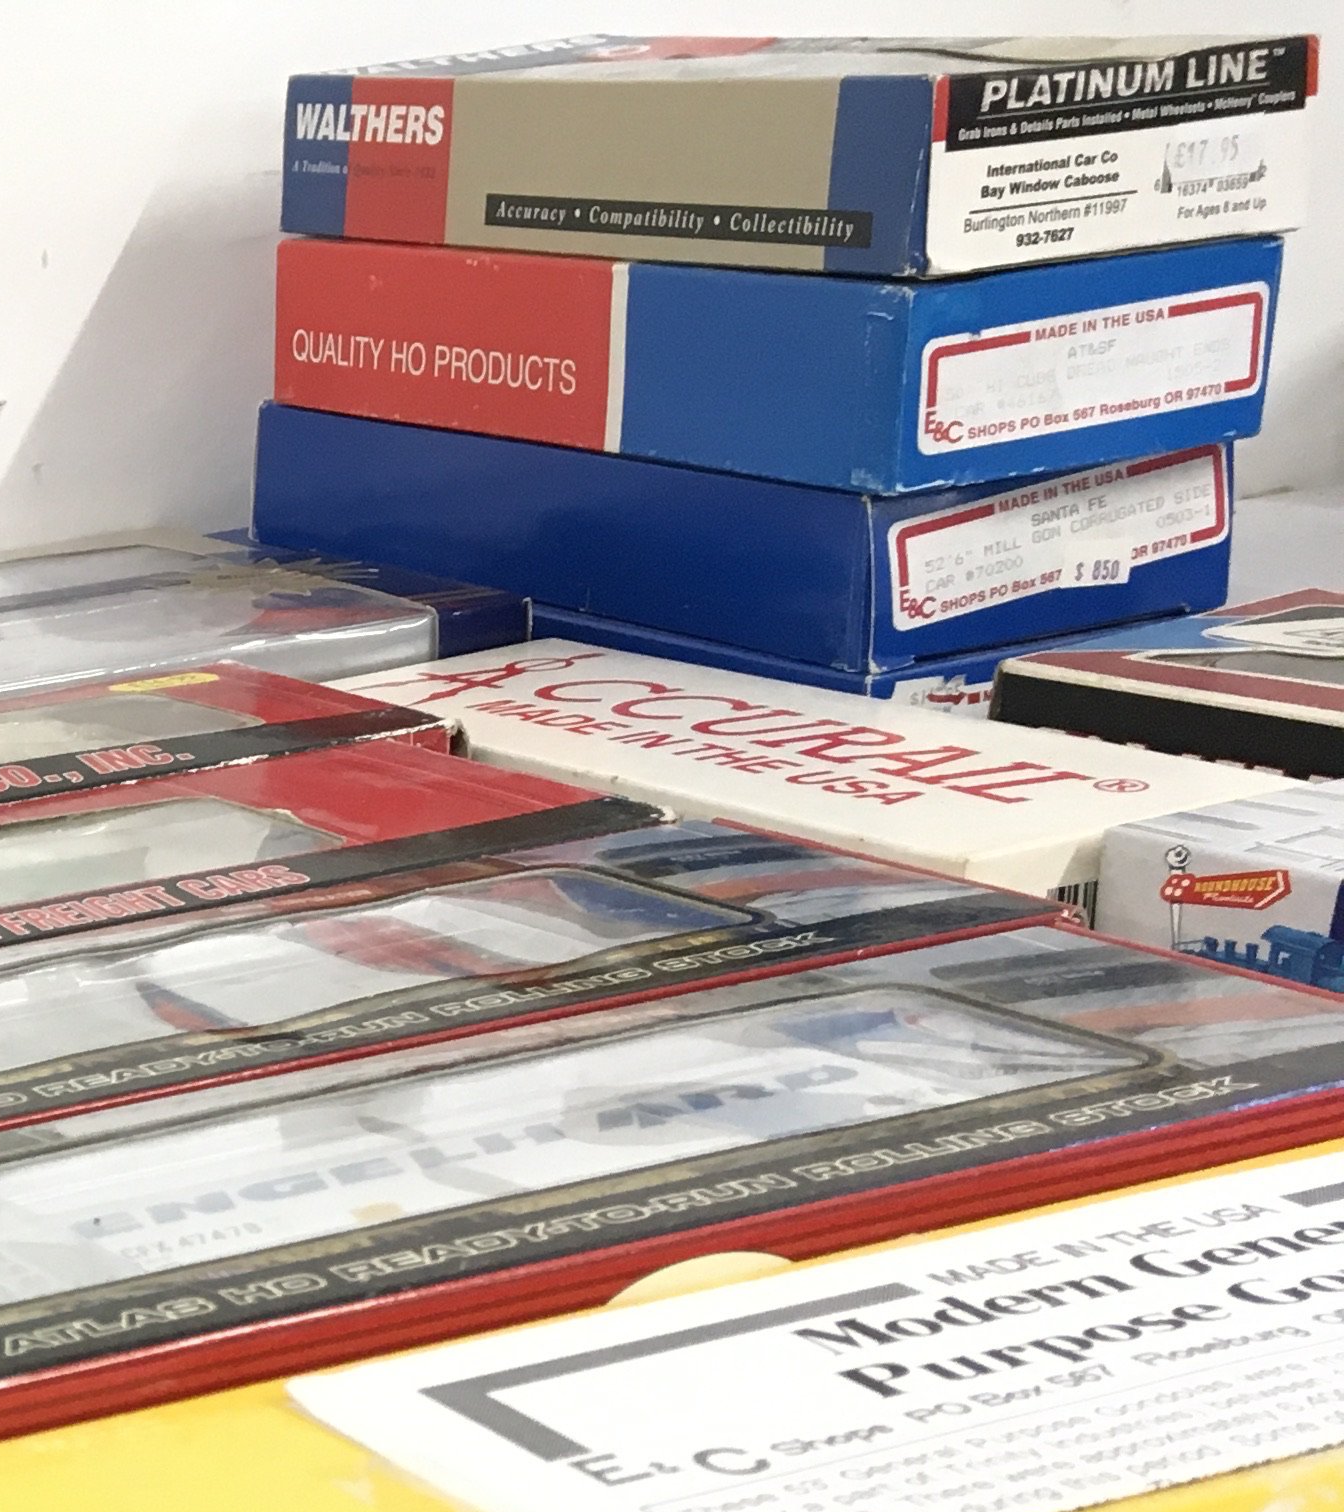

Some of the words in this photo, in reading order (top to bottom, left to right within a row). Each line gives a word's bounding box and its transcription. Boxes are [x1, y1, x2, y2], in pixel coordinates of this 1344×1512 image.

[980, 60, 1175, 112] PLATINUM
[1186, 49, 1269, 88] LINE
[296, 102, 445, 145] WALTHERS
[958, 127, 981, 141] Grab
[983, 125, 1007, 138] Irons
[1010, 123, 1017, 135] &
[1020, 119, 1053, 133] Details
[1055, 117, 1080, 129] Parts
[1082, 110, 1122, 126] Installed
[986, 156, 1071, 178] International
[1074, 153, 1098, 167] Car
[1100, 150, 1119, 164] Co
[980, 185, 1005, 199] Bay
[1009, 178, 1060, 195] Window
[1064, 172, 1120, 188] Caboose
[495, 201, 567, 225] Accuracy
[588, 205, 705, 234] Compatibility
[729, 212, 855, 243] Collectibility
[963, 212, 1025, 233] Burlington
[1028, 206, 1081, 225] Northern
[1083, 198, 1128, 217] #11997
[1177, 206, 1195, 219] For
[1232, 199, 1250, 212] and
[1253, 197, 1267, 211] Up
[1034, 324, 1078, 342] MADE
[1082, 319, 1097, 333] IN
[1103, 313, 1130, 329] THE
[1135, 308, 1166, 324] USA
[291, 328, 385, 371] QUALITY
[390, 340, 426, 376] HO
[433, 344, 577, 396] PRODUCTS
[1067, 338, 1118, 360] AT&SF
[924, 410, 965, 445] E&C
[967, 419, 1016, 440] SHOPS
[1020, 415, 1040, 431] PO
[1044, 410, 1069, 426] Box
[1100, 395, 1161, 417] Roseburg
[1164, 388, 1184, 404] OR
[1187, 382, 1223, 401] 97470
[999, 491, 1040, 513] MADE
[1044, 486, 1058, 501] IN
[1062, 478, 1090, 497] THE
[1094, 468, 1125, 489] USA
[1031, 503, 1080, 528] SANTA
[1087, 495, 1108, 511] FE
[984, 537, 1022, 558] MILL
[1032, 527, 1061, 545] GON
[1069, 496, 1165, 534] CORRUGATED
[1174, 484, 1212, 505] SIDE
[925, 574, 956, 595] CAR
[1091, 559, 1121, 581] 850
[900, 586, 937, 620] E&C
[940, 590, 985, 614] SHOPS
[989, 584, 1007, 601] PO
[1012, 578, 1037, 594] Box
[387, 652, 1100, 804] ACCURAIL
[92, 743, 195, 778] INC.
[467, 699, 603, 736] MADE
[610, 729, 667, 750] IN
[674, 741, 771, 776] THE
[785, 769, 926, 806] USA
[176, 863, 312, 901] CARS
[432, 966, 653, 1021] ROLLING
[651, 929, 835, 974] STOCK
[3, 1296, 219, 1358] ATLAS
[217, 1271, 329, 1309] HO
[792, 1119, 1055, 1182] ROLLING
[1047, 1074, 1260, 1126] STOCK
[926, 1249, 1062, 1287] MADE
[1053, 1239, 1108, 1259] IN
[1097, 1218, 1198, 1247] THE
[1183, 1203, 1281, 1229] USA
[791, 1273, 1138, 1356] Modern
[1129, 1219, 1344, 1279] Gene
[837, 1303, 1232, 1399] Purpose
[1226, 1272, 1344, 1305] Go
[770, 1424, 894, 1457] Shops
[905, 1401, 973, 1423] PO
[969, 1383, 1046, 1408] Box
[1131, 1324, 1313, 1366] Roseburg
